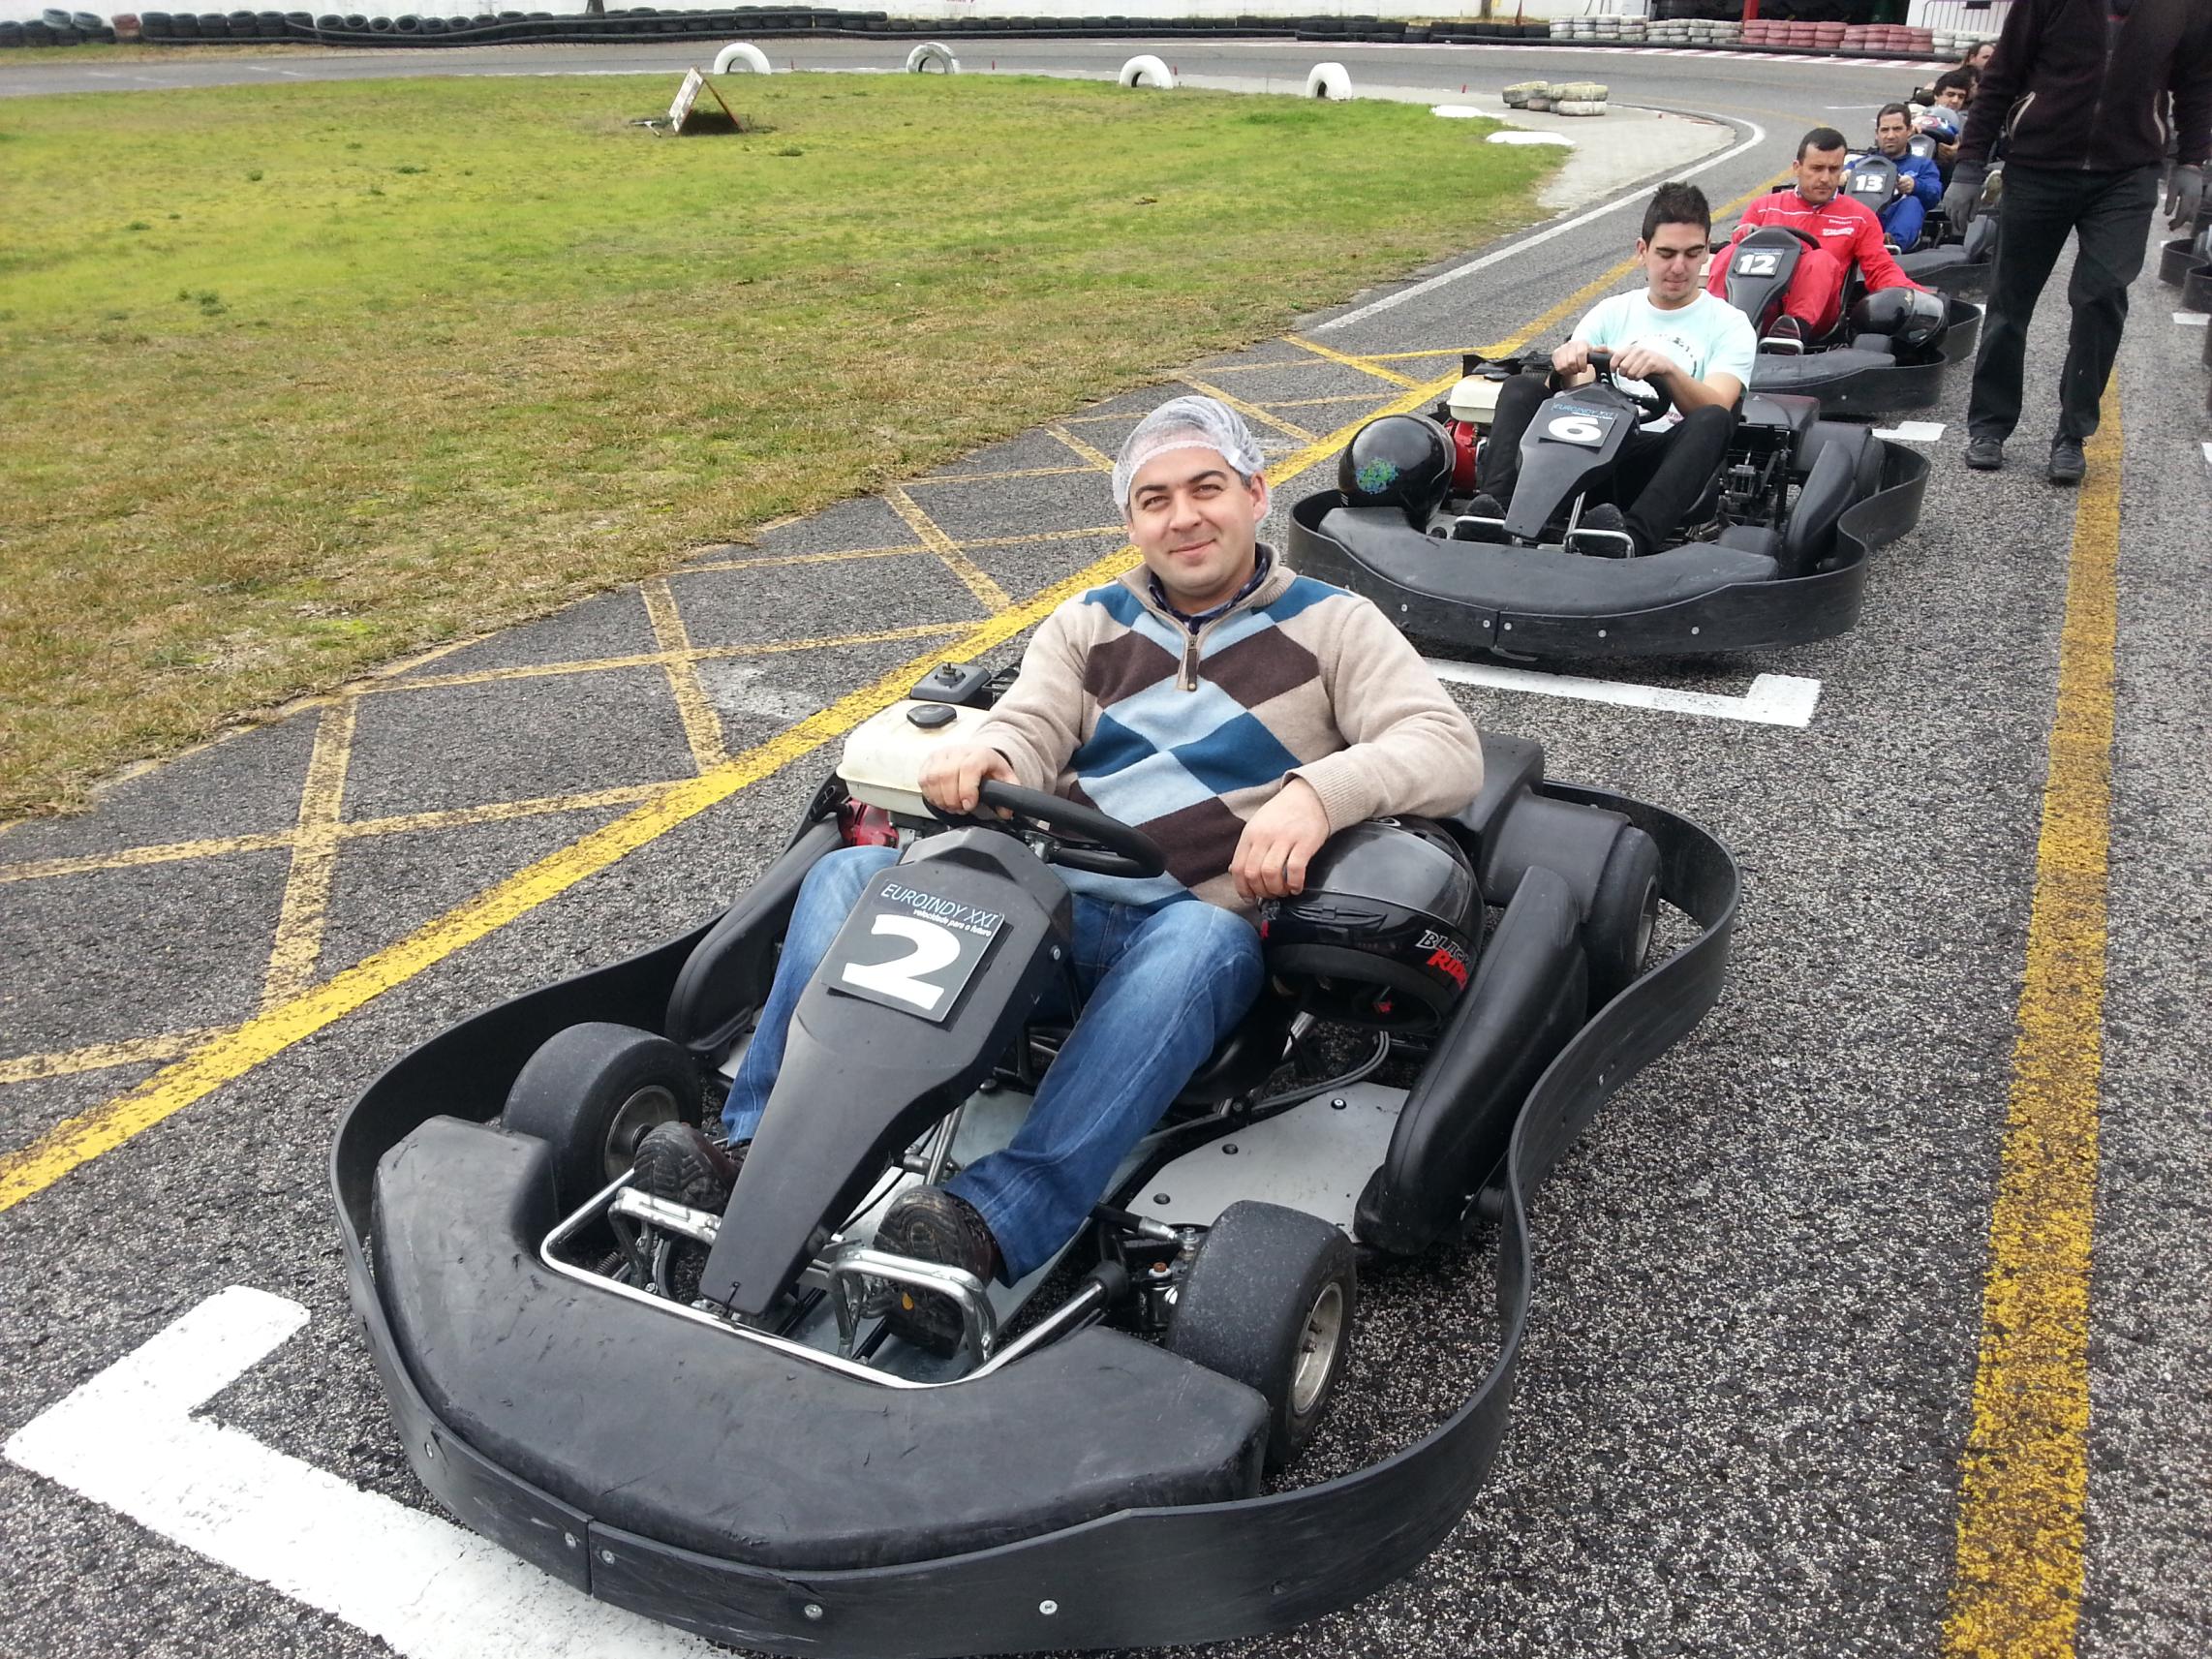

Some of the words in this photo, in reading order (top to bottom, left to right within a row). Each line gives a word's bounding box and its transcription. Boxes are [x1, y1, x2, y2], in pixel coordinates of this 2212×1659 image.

[1856, 174, 1884, 191] 13
[1738, 254, 1776, 273] 12
[1549, 415, 1602, 442] 6
[880, 883, 968, 917] EUROINDY
[964, 908, 998, 928] XXI
[842, 913, 961, 1010] 2
